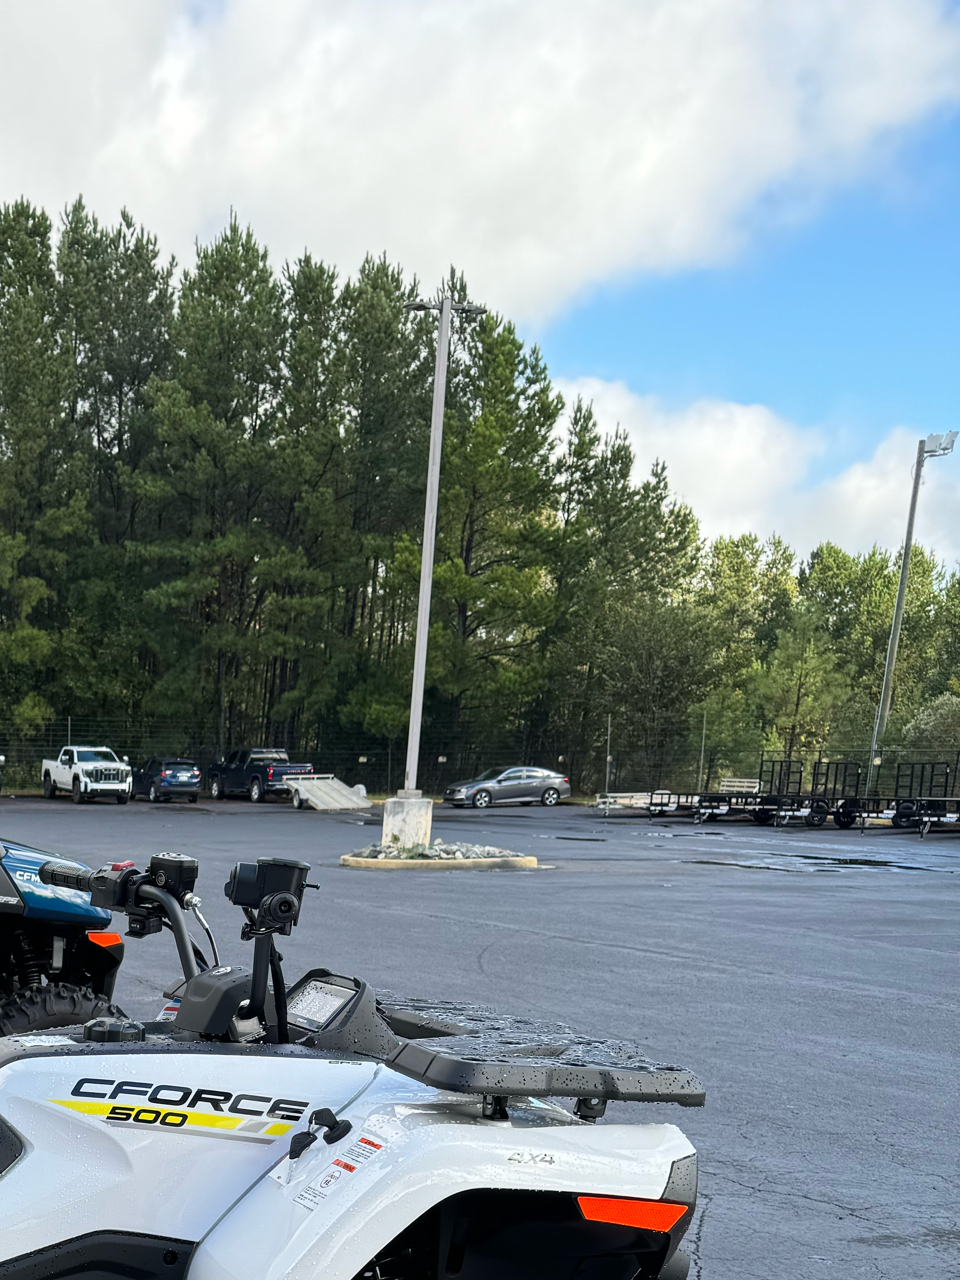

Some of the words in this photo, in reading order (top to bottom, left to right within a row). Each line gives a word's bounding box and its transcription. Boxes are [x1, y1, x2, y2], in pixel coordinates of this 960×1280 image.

[15, 870, 42, 883] CFM
[71, 1077, 310, 1121] CFORCE
[106, 1106, 189, 1127] 500
[507, 1152, 555, 1165] 4X4
